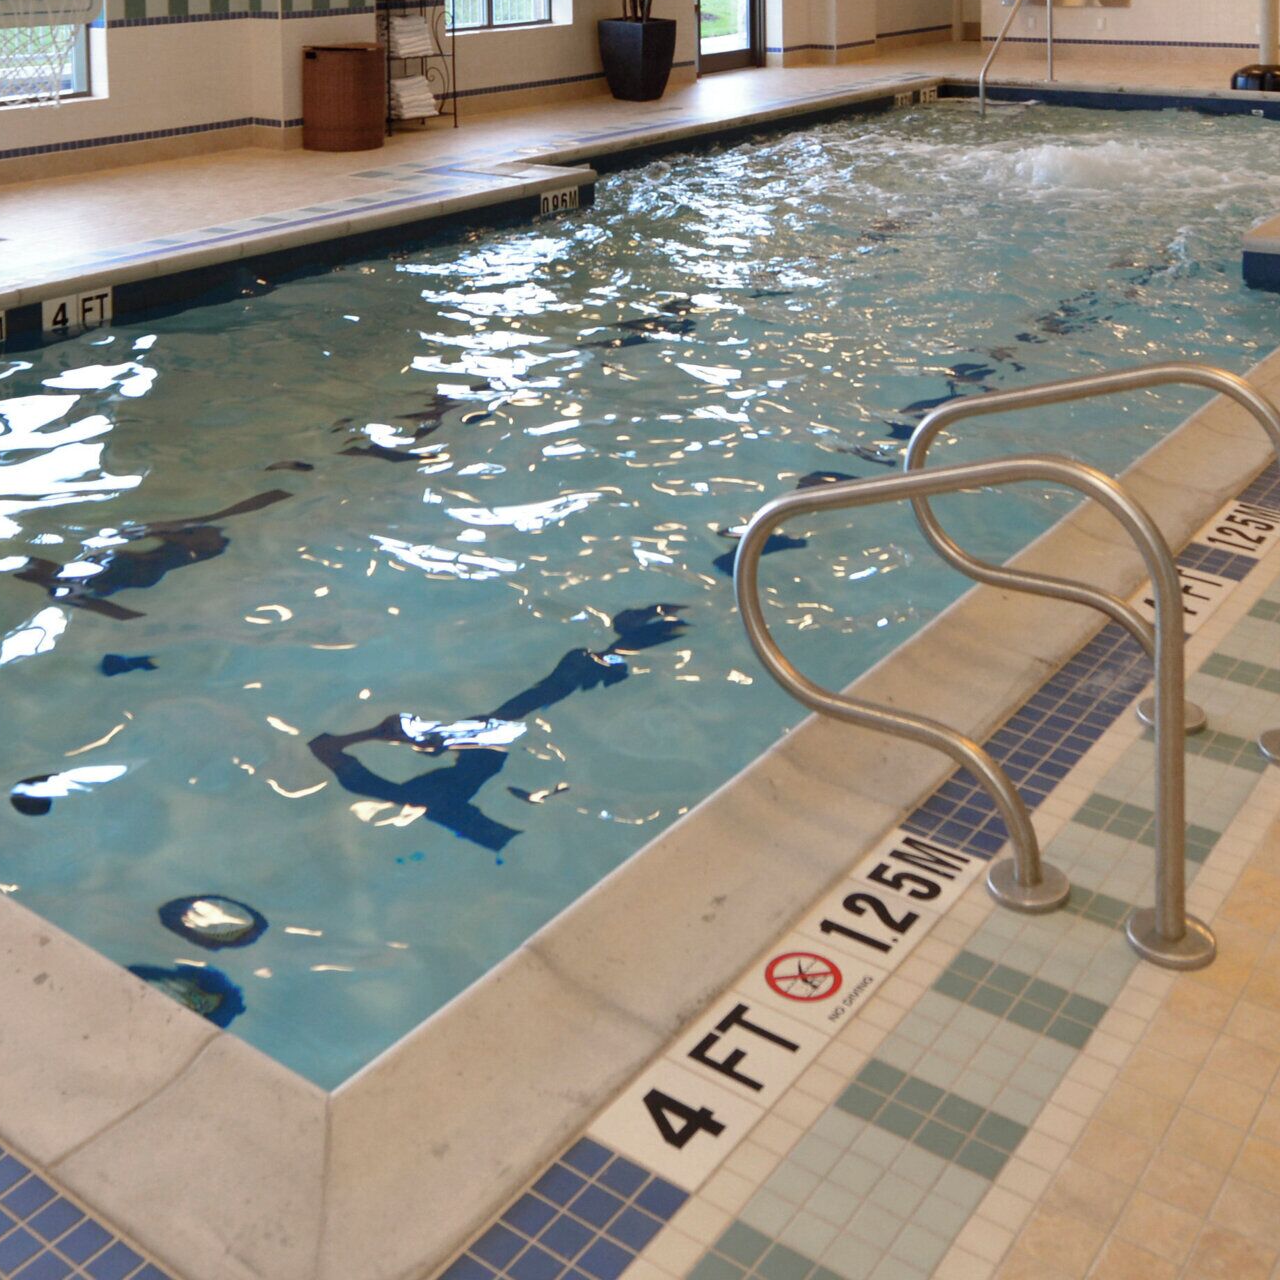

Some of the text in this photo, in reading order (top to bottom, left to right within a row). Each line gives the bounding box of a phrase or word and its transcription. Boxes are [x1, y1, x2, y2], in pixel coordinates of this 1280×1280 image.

[51, 302, 69, 327] 4
[81, 293, 109, 326] FT
[642, 836, 971, 1150] 4 FT 1.25M
[828, 975, 873, 1022] NO DIVING
